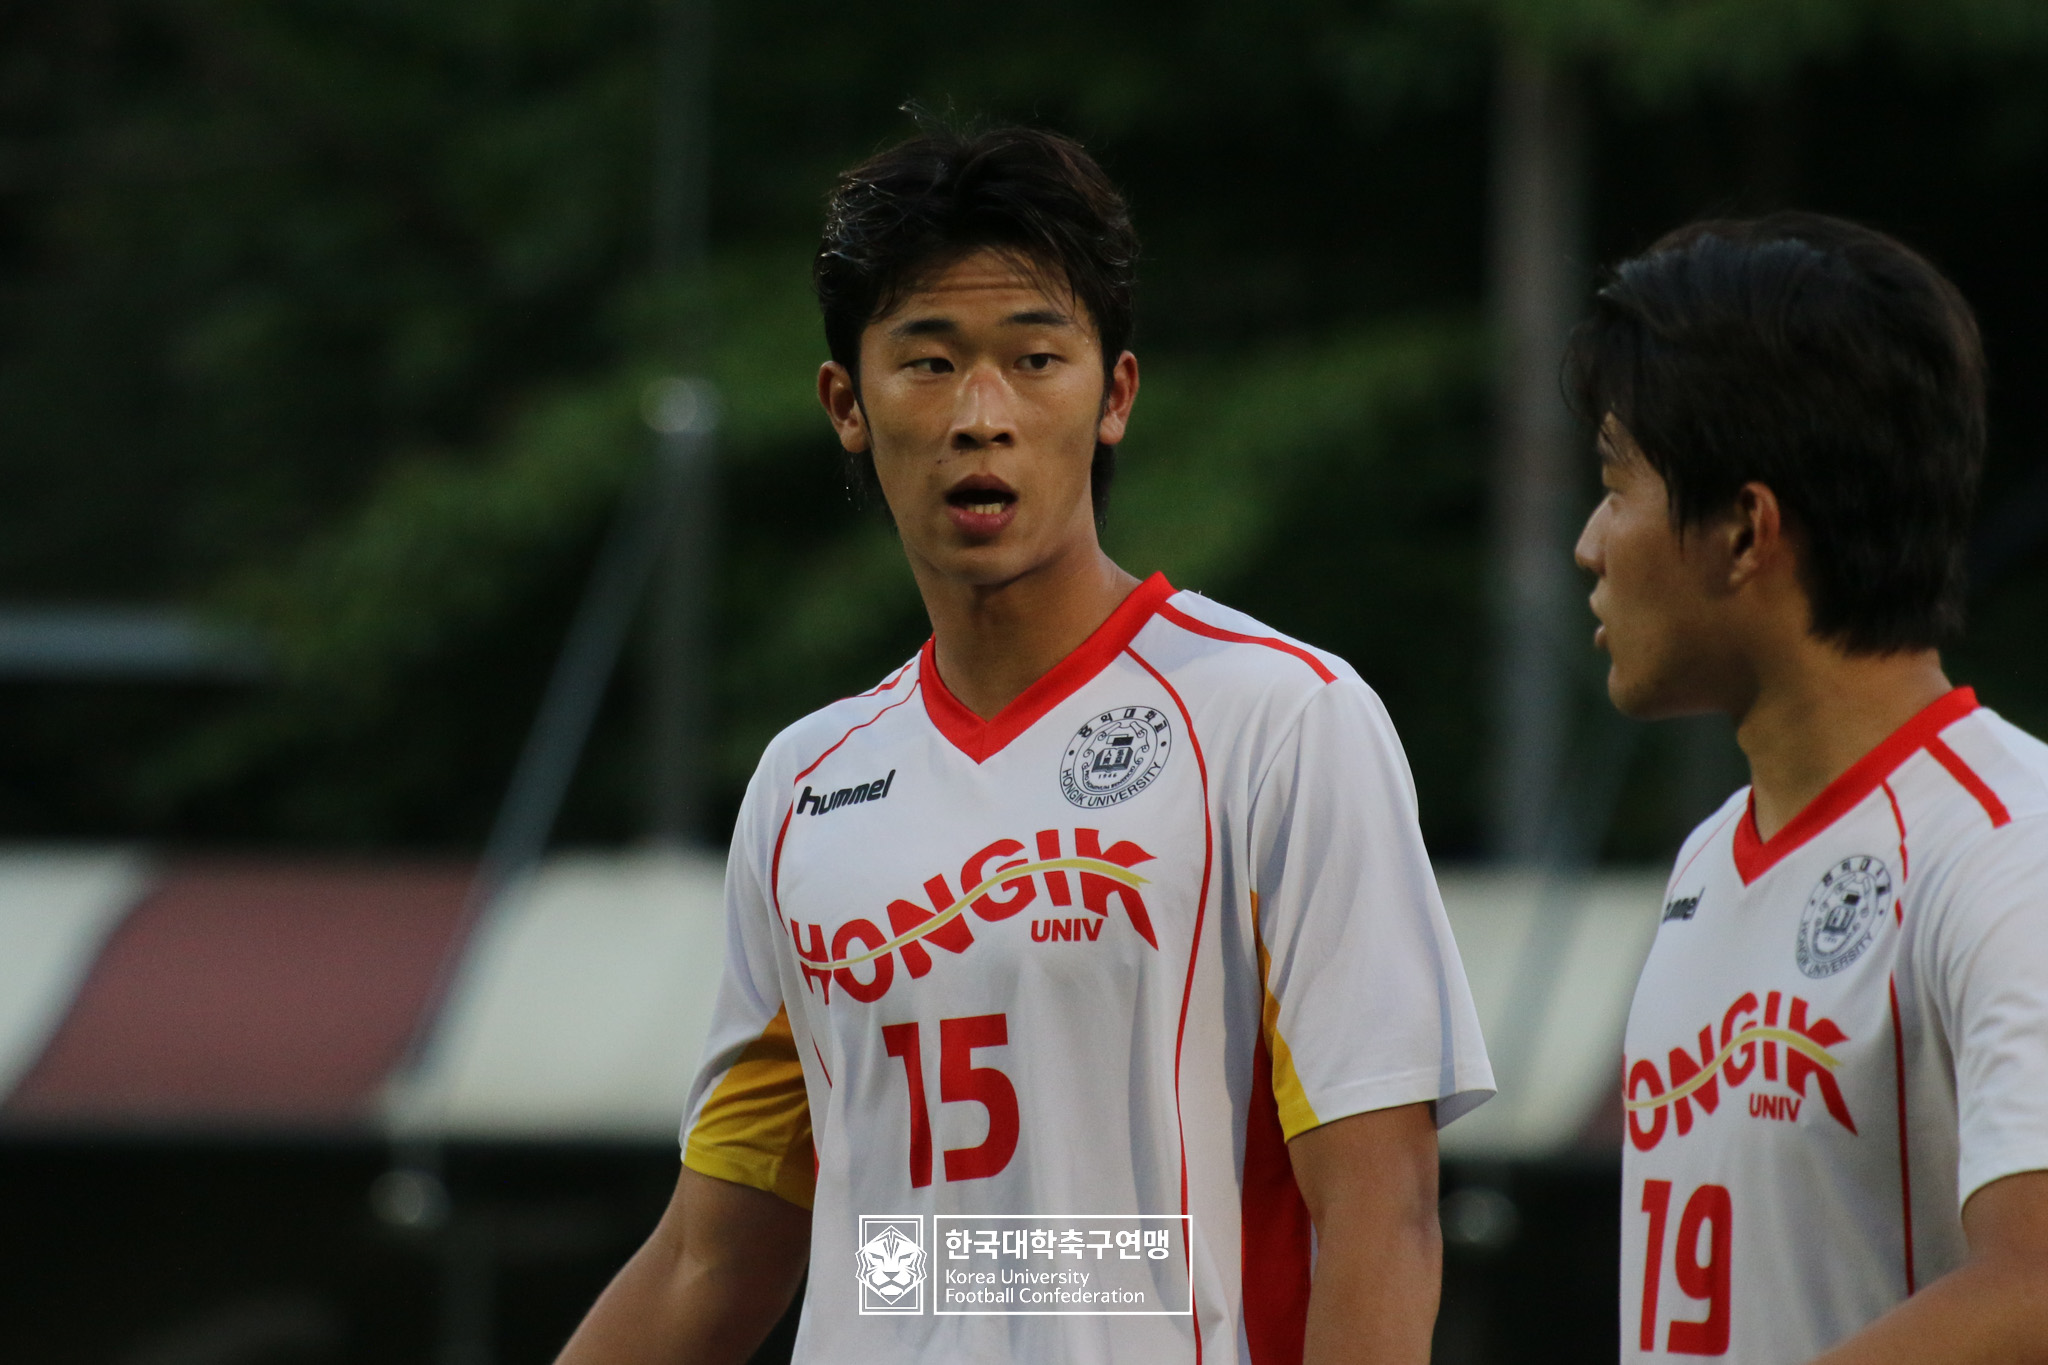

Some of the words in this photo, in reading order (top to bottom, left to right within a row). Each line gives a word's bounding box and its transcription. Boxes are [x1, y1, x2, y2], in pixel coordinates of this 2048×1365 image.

[796, 769, 896, 816] hummel
[1062, 768, 1087, 805] HONGIK
[1088, 761, 1161, 806] UNIVERSITY
[790, 827, 1159, 1005] HONGIK
[1030, 918, 1104, 942] UNIV
[882, 1013, 1020, 1189] 15
[1622, 991, 1859, 1152] ONGIK
[1749, 1092, 1802, 1122] UNIV
[1639, 1179, 1733, 1357] 19
